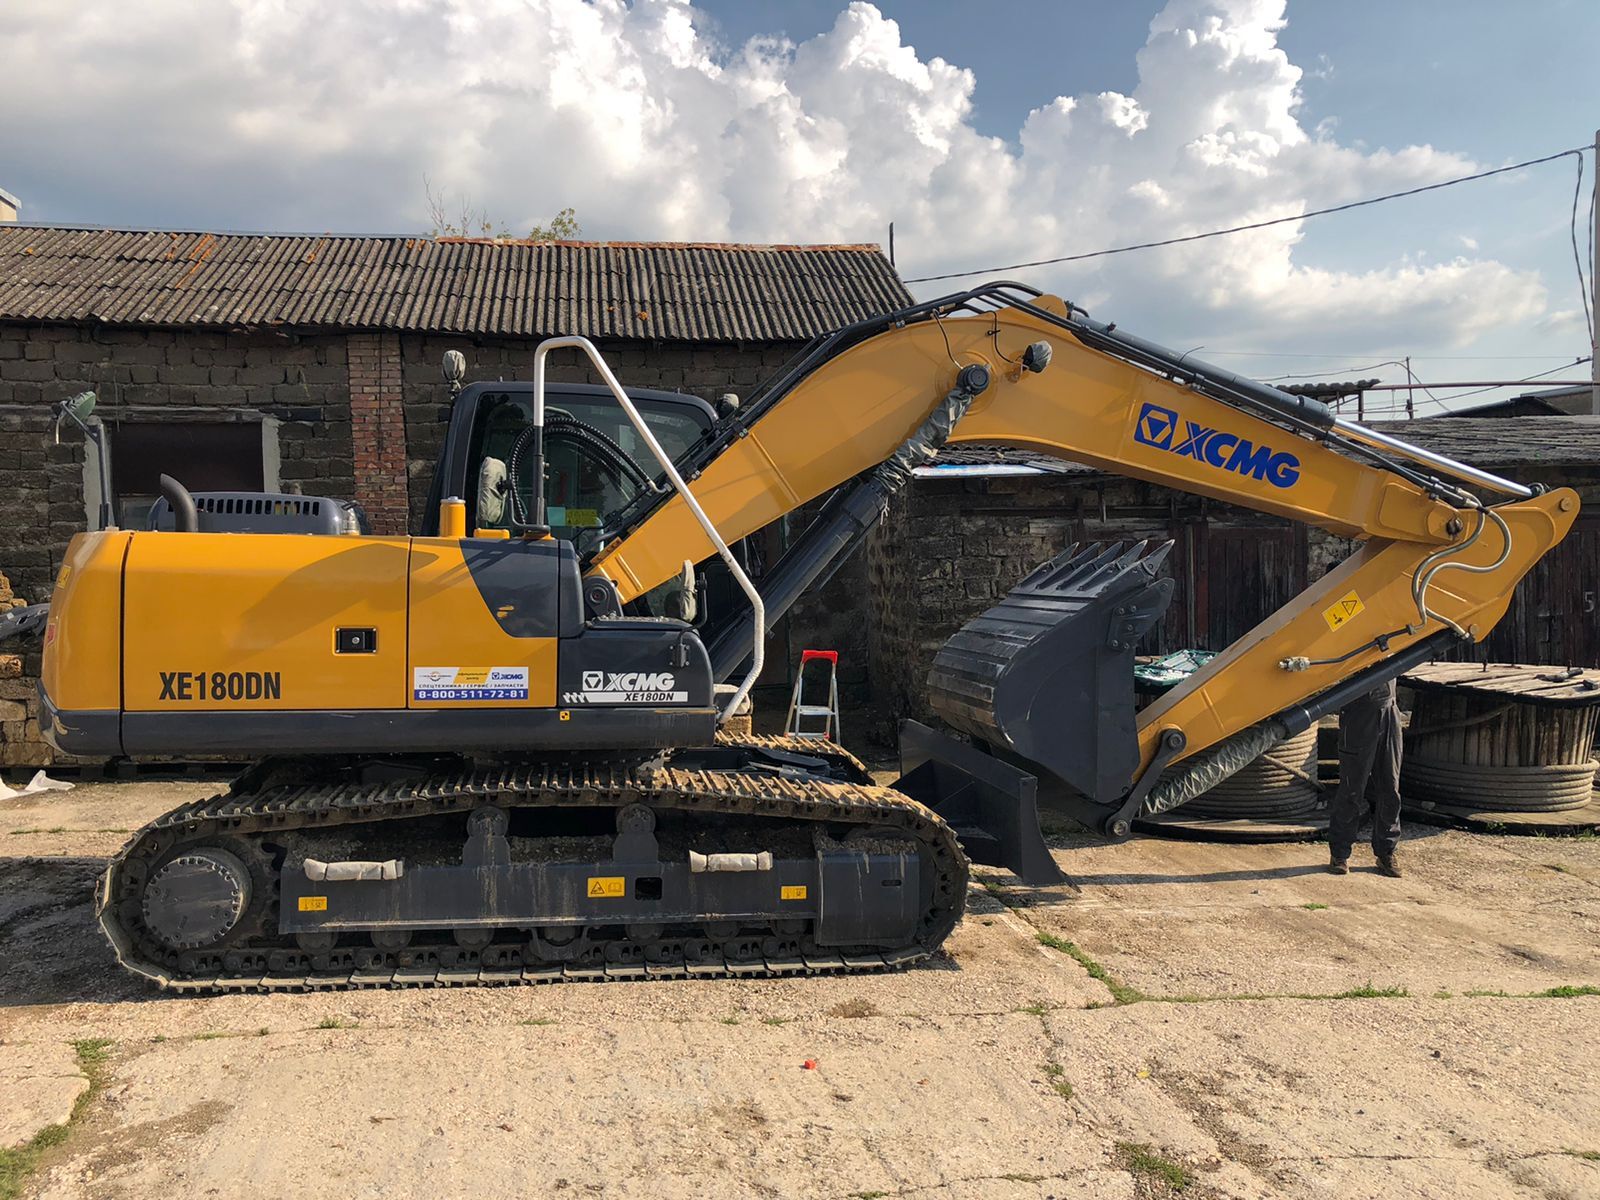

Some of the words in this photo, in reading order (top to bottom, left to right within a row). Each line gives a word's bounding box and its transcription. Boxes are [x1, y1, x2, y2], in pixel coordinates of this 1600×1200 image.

[1170, 420, 1300, 488] XCMG
[1584, 591, 1594, 612] 5
[159, 672, 280, 701] XE180DN
[603, 672, 675, 691] XCMG
[418, 690, 524, 699] 8-800-511-72-81
[624, 693, 675, 702] XE180DN
